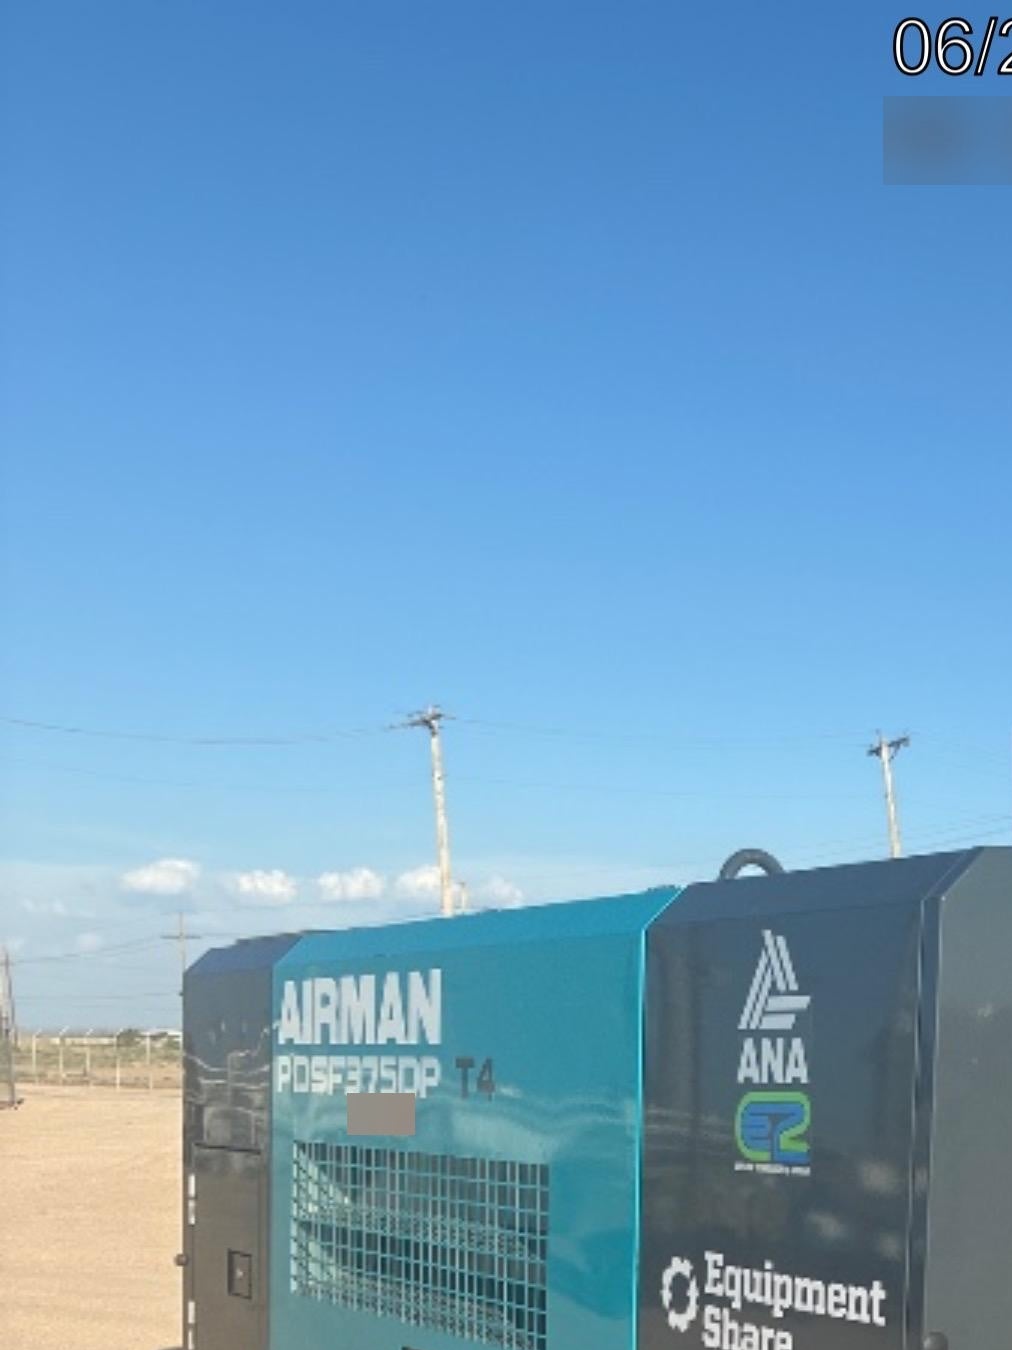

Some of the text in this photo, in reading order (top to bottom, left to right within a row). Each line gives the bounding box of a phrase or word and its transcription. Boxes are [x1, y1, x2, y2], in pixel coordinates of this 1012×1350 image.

[278, 968, 442, 1046] AIRMAN
[455, 1056, 496, 1101] T4
[737, 1036, 809, 1084] ANA
[704, 1250, 887, 1327] Equipment
